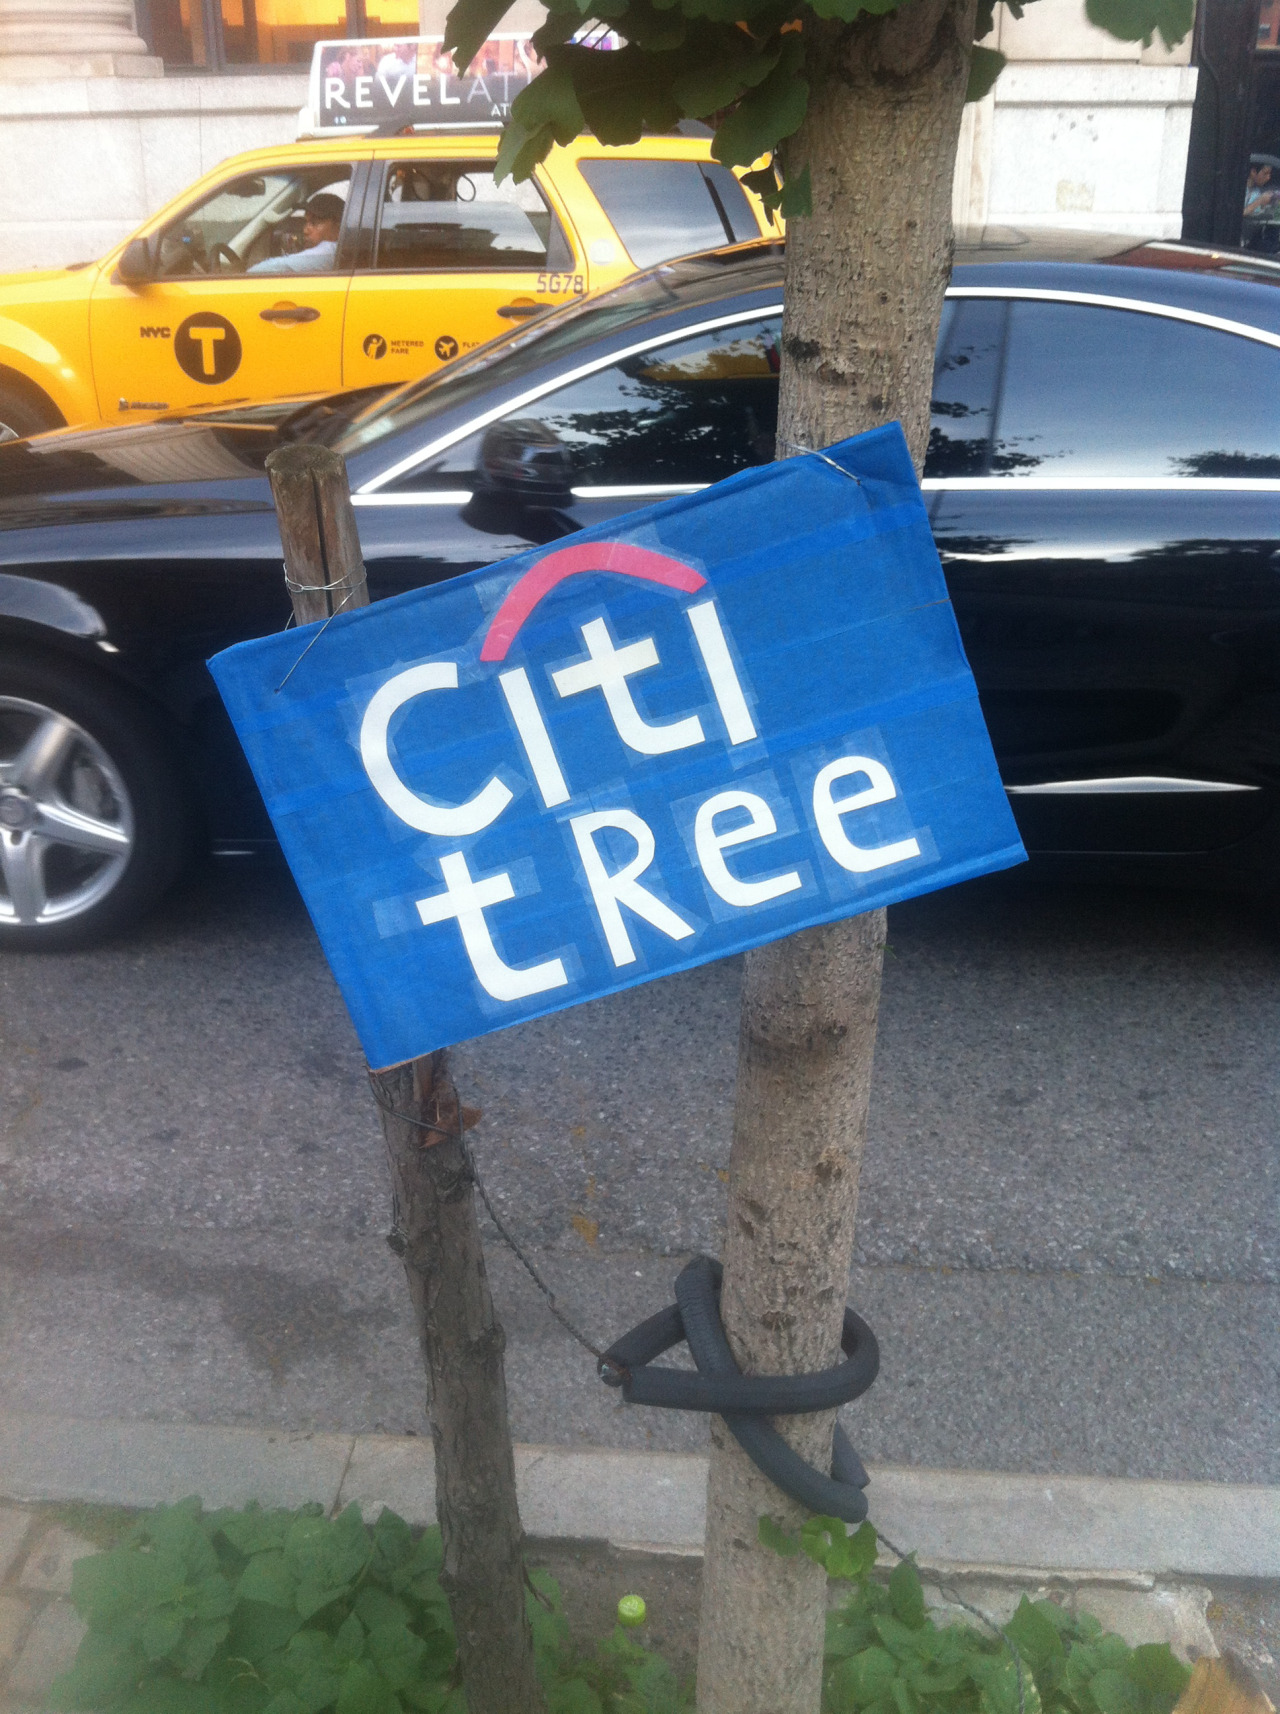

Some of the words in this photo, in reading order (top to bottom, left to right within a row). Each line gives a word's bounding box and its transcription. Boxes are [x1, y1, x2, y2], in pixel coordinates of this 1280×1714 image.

[536, 273, 584, 294] 5G78
[140, 326, 171, 339] NYC
[189, 327, 226, 375] T
[391, 340, 424, 348] METERED
